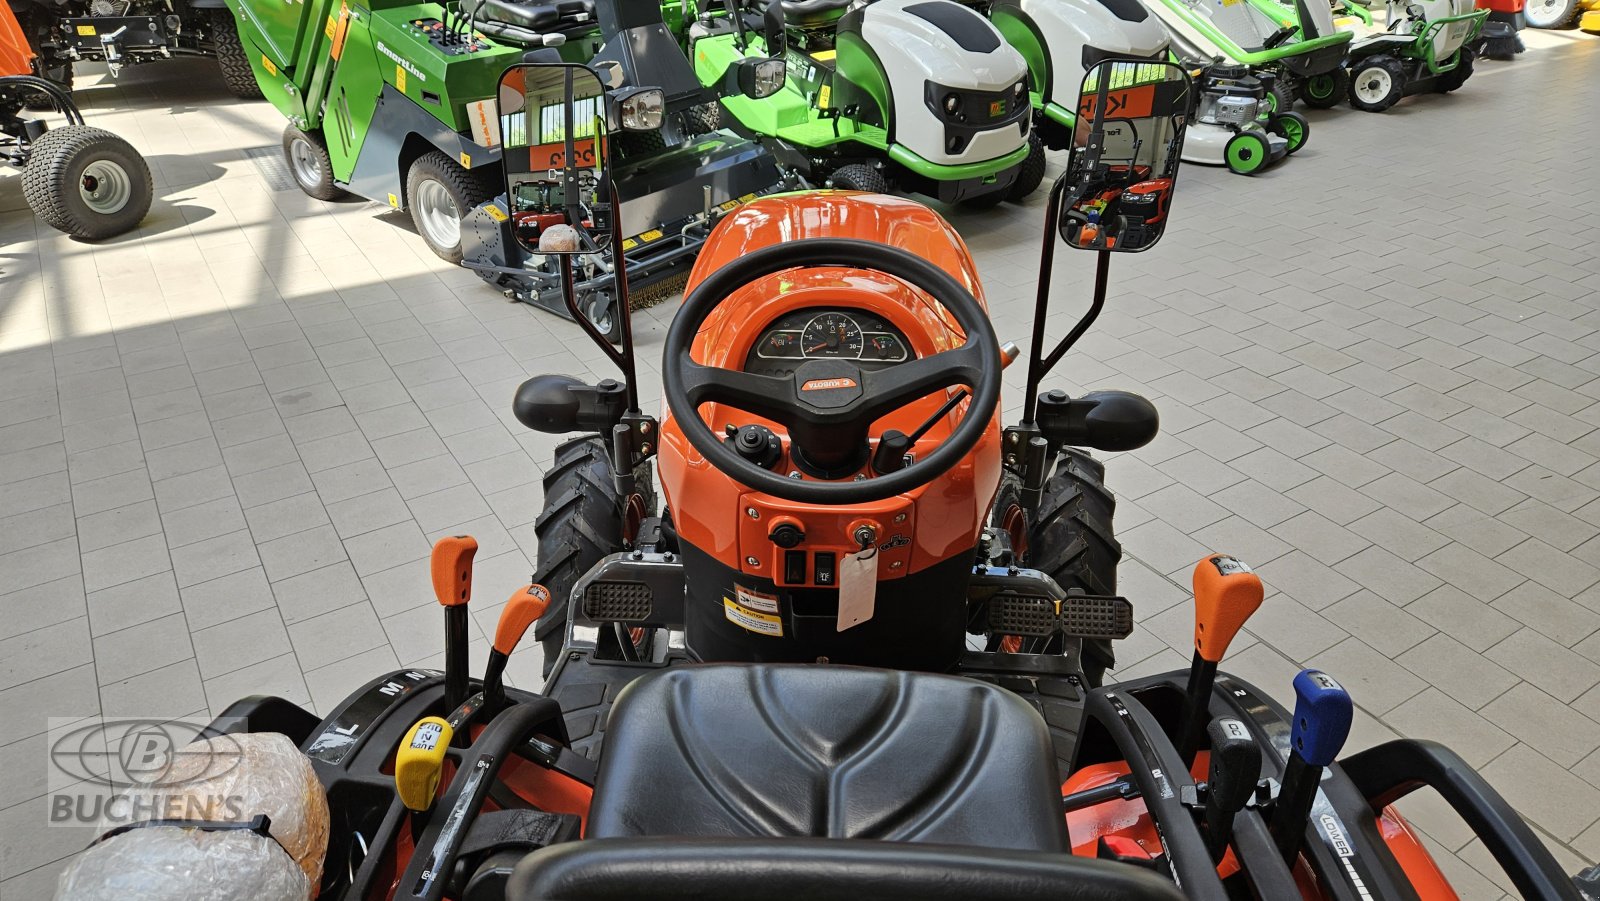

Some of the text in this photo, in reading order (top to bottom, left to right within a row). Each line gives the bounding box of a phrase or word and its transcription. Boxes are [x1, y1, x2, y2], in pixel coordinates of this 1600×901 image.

[377, 41, 427, 82] SmartLine
[809, 380, 840, 389] KUBOTA
[405, 671, 426, 681] N
[379, 681, 404, 696] M
[336, 723, 359, 736] L
[1228, 723, 1242, 736] DC
[421, 733, 432, 741] N
[1322, 817, 1350, 855] LOWER
